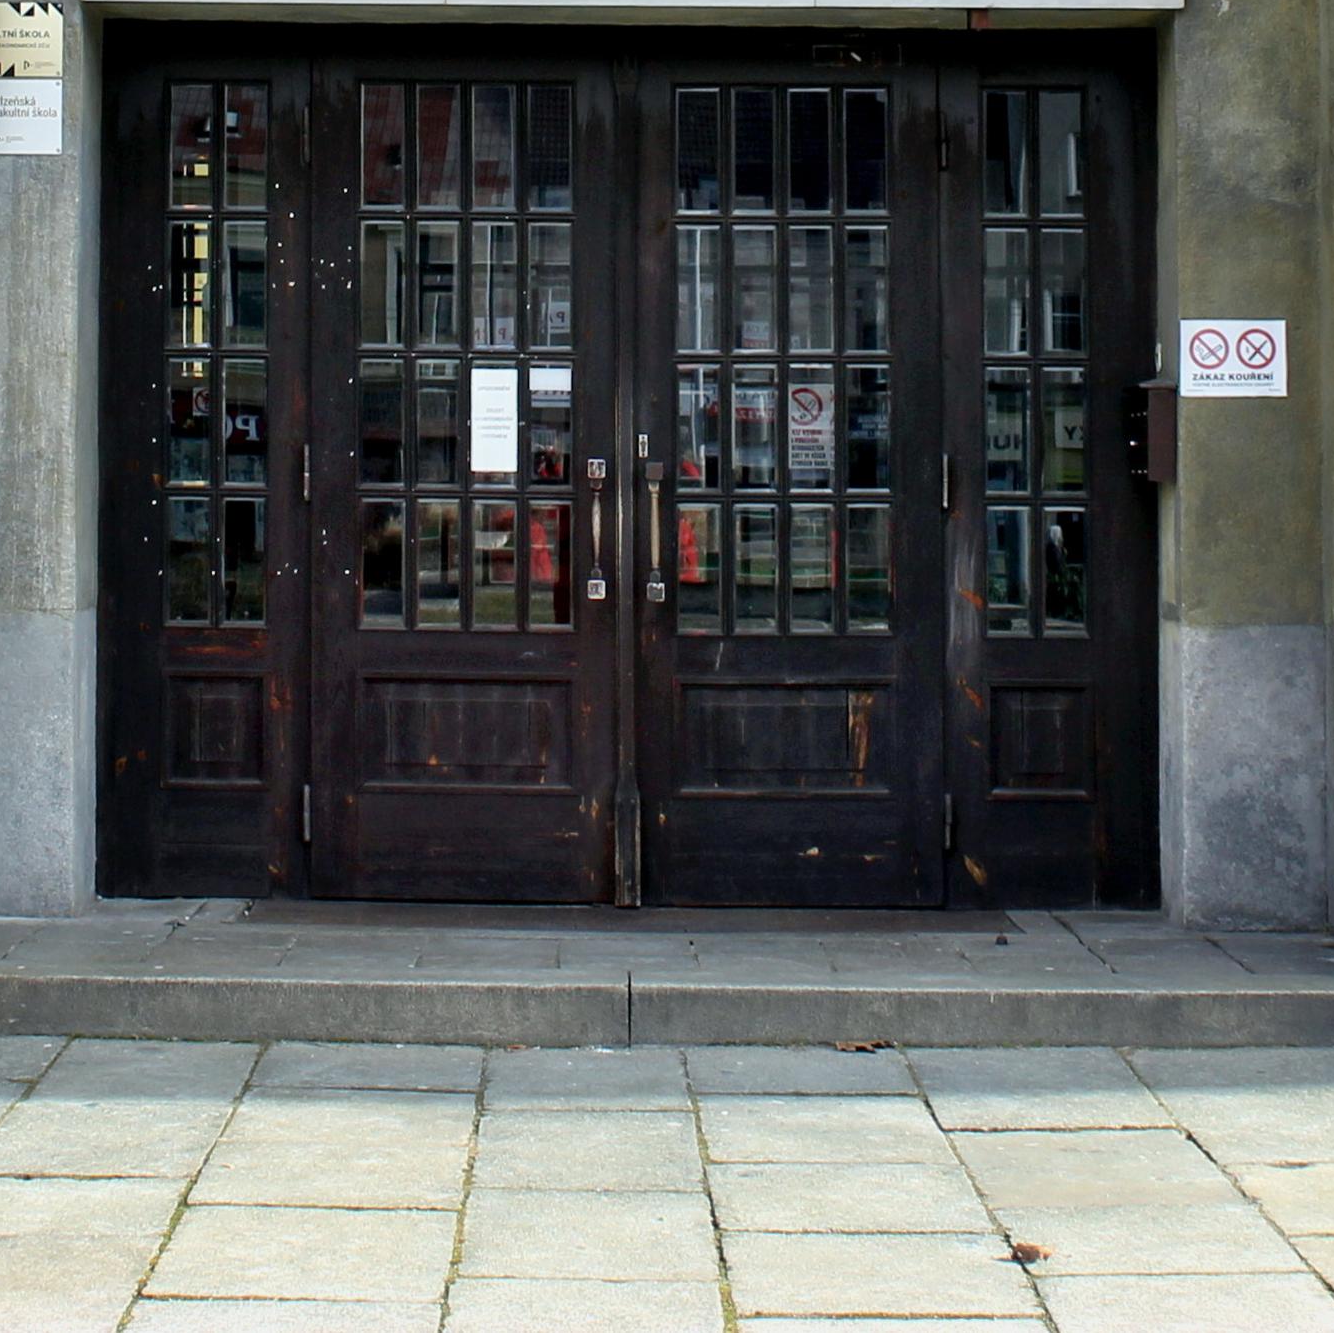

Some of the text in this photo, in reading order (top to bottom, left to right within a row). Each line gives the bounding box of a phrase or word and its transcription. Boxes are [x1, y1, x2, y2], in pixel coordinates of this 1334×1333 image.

[19, 28, 51, 39] ŠKOLA
[32, 107, 58, 118] škola
[1192, 371, 1274, 381] ZÁKAZ KOUŘENÍ
